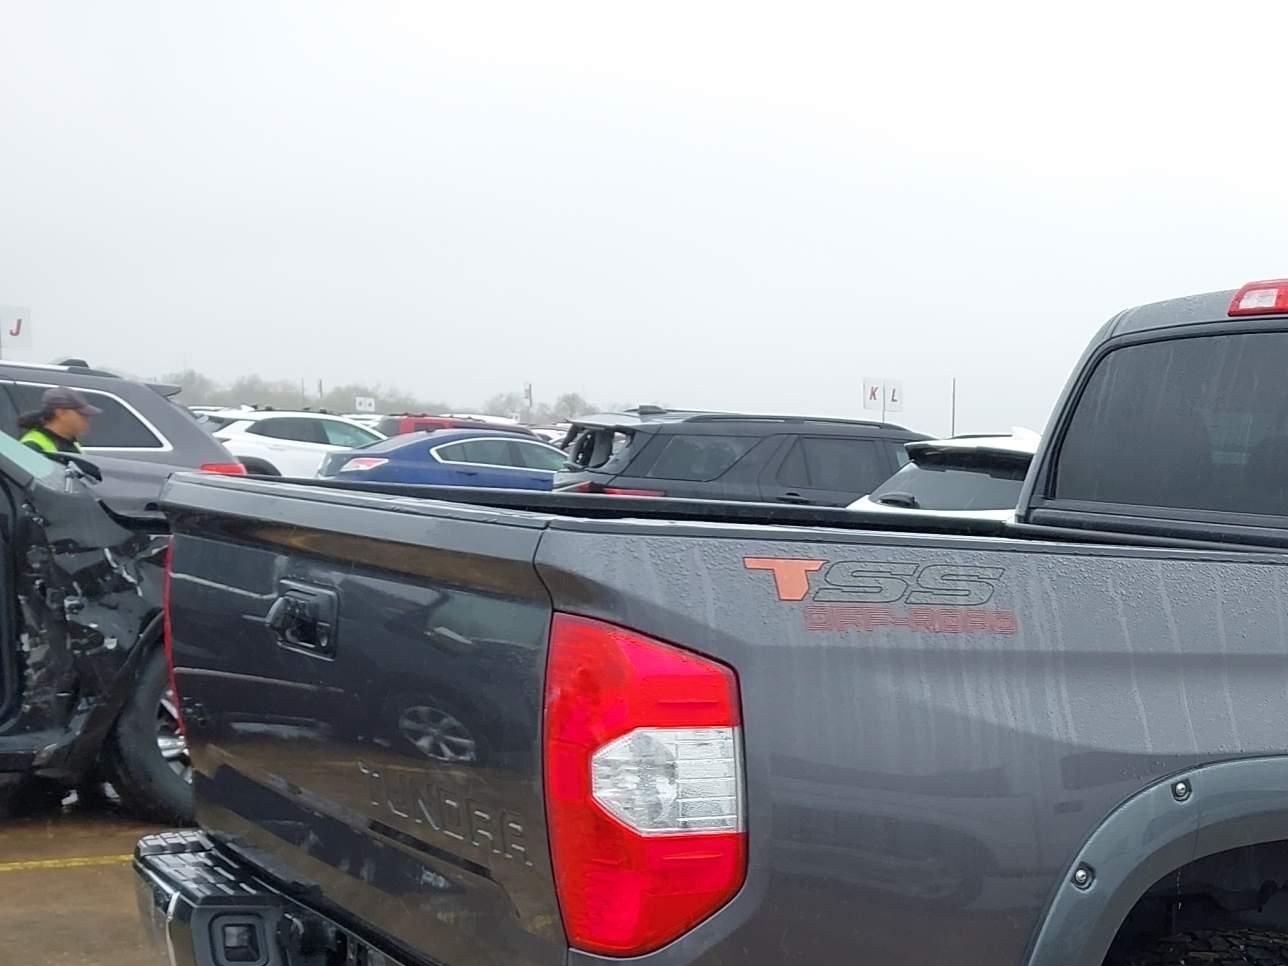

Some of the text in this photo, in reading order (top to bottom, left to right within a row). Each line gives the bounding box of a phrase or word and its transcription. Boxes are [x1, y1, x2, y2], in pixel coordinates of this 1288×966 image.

[9, 317, 23, 337] J
[869, 385, 879, 401] K
[891, 387, 899, 403] L
[742, 556, 1006, 606] TSS
[803, 605, 1019, 637] OFF-ROAD
[357, 760, 535, 868] TUNDRA
